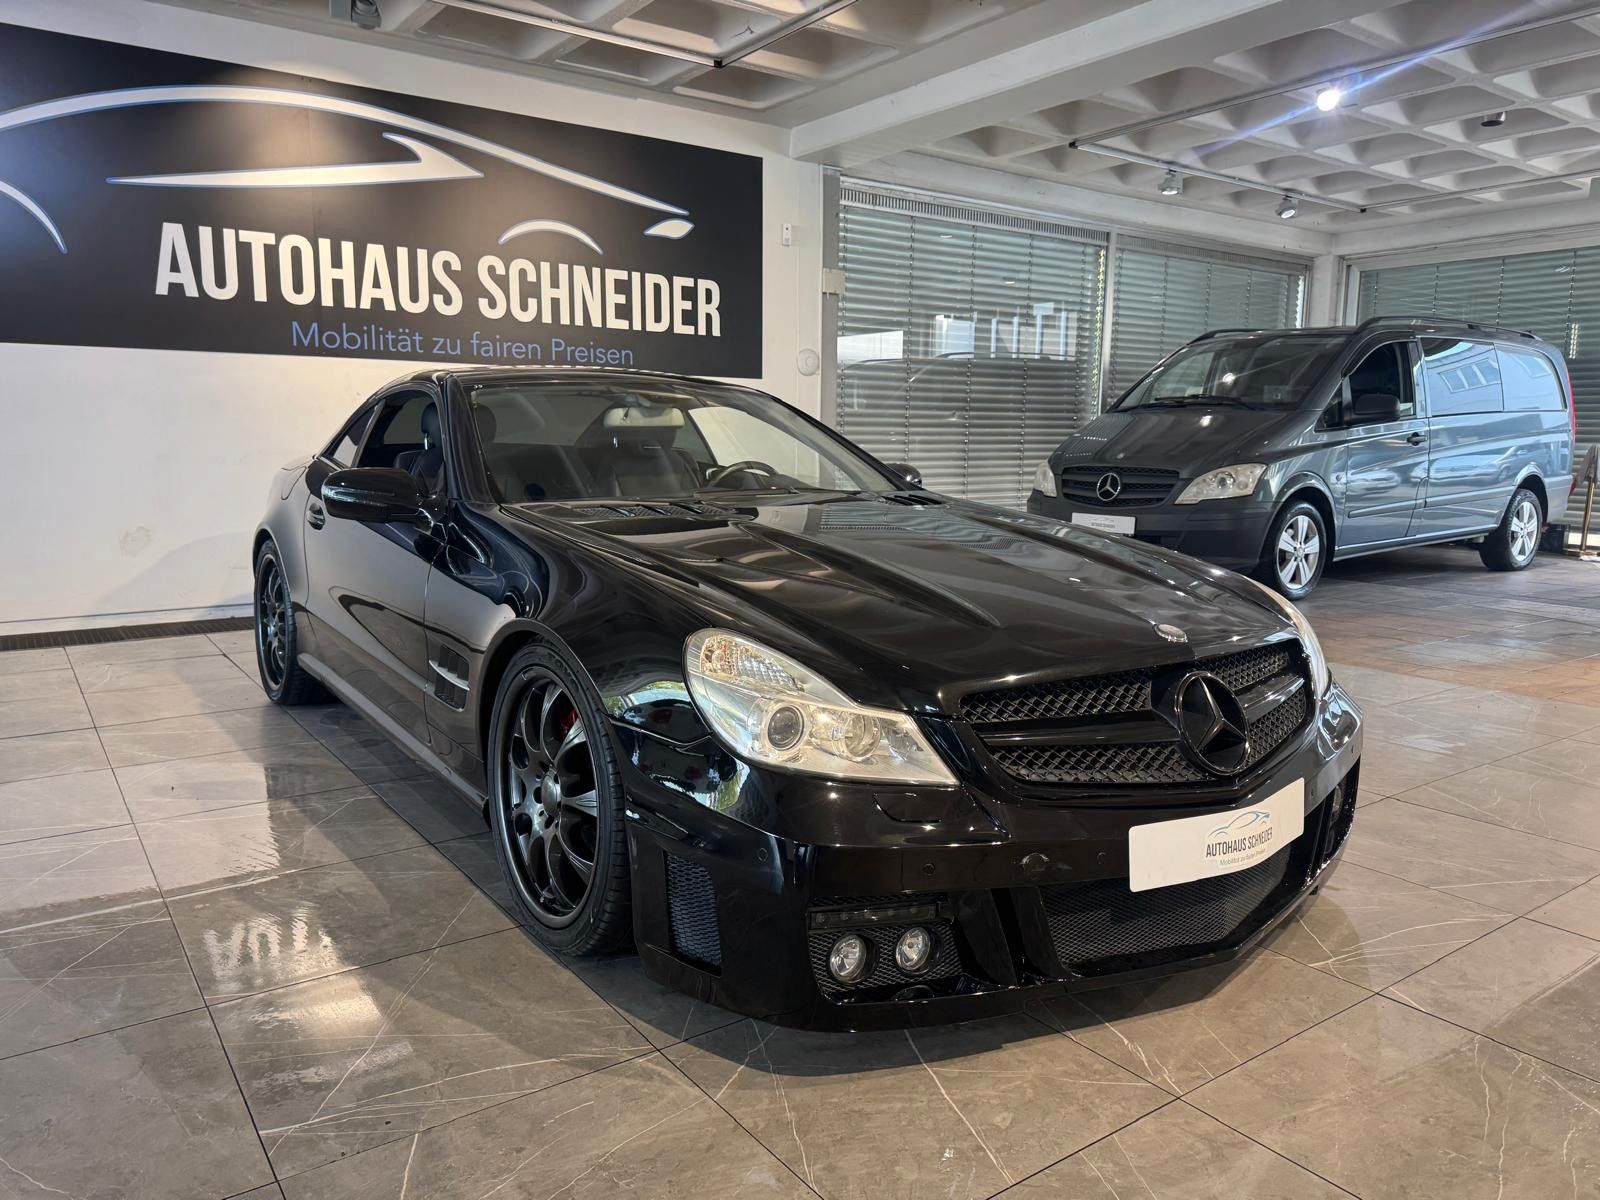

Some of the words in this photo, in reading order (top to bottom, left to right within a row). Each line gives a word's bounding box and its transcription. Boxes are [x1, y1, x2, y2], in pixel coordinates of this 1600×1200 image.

[155, 222, 463, 316] AUTOHAUS
[477, 255, 721, 337] SCHNEIDER
[292, 321, 424, 353] Mobilität
[432, 337, 461, 355] zu
[470, 331, 541, 359] fairen
[551, 338, 634, 365] Preisen
[1206, 837, 1247, 858] AUTOHAUS
[1247, 827, 1273, 850] SCHNEIDER
